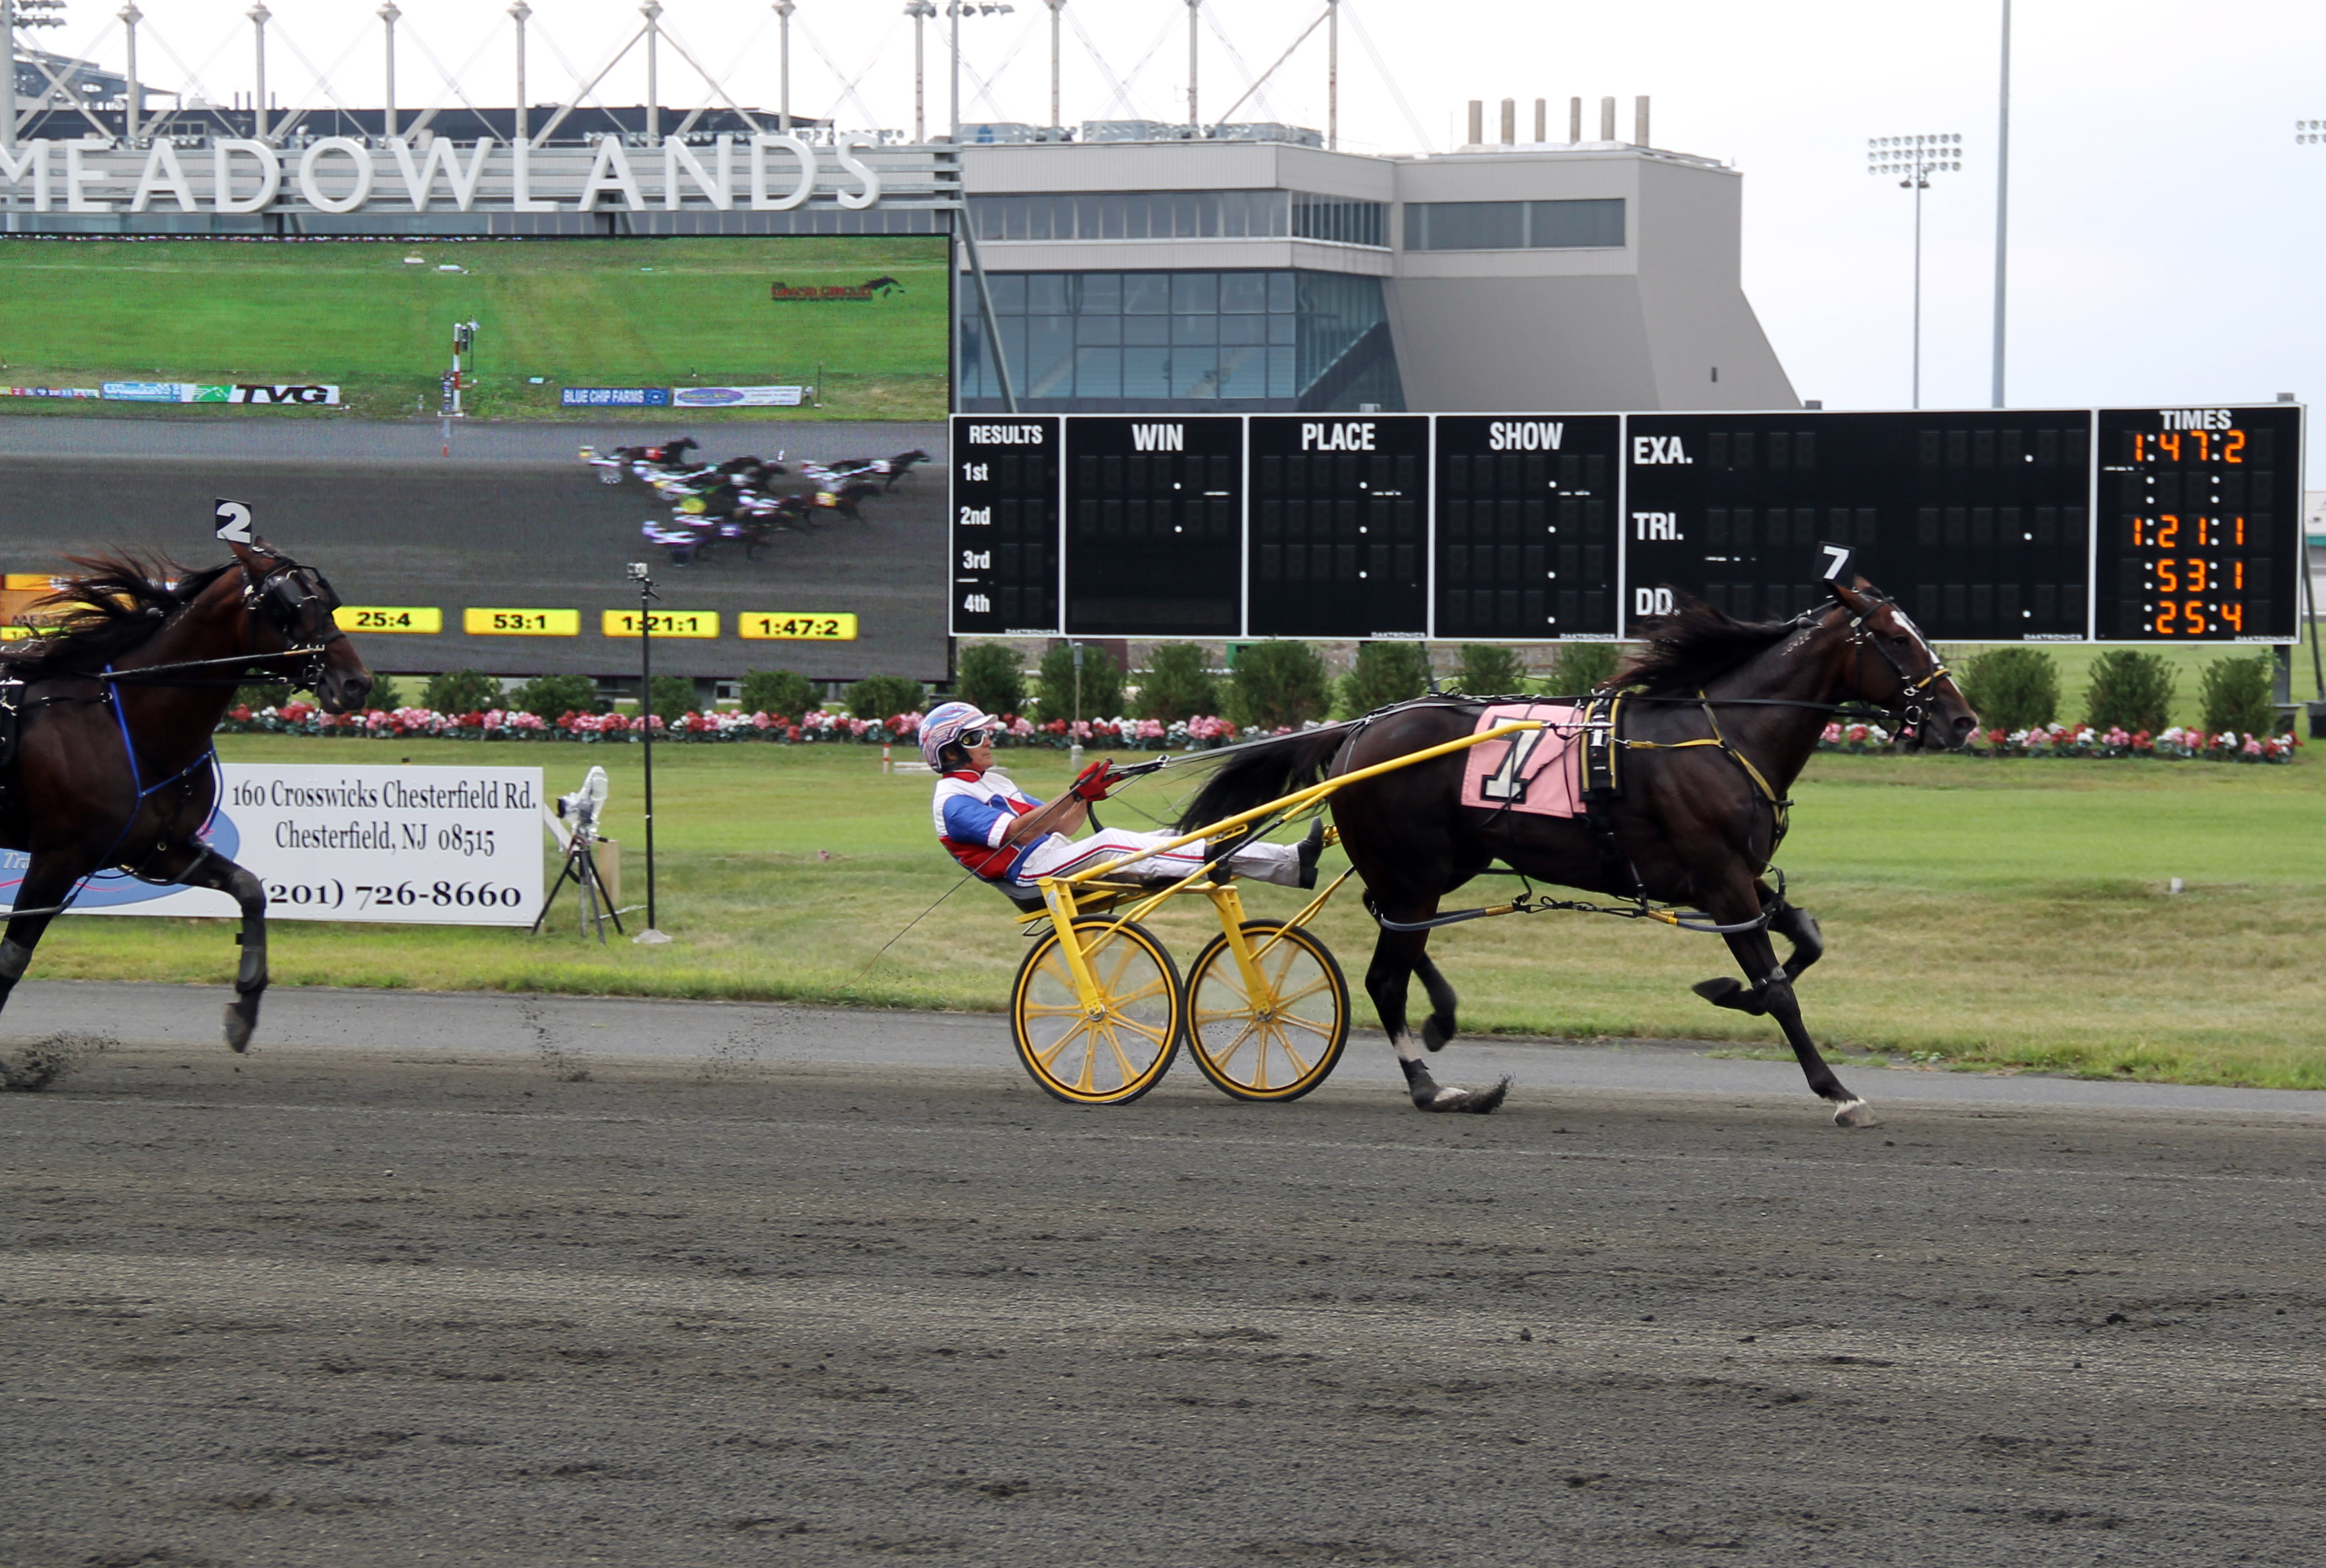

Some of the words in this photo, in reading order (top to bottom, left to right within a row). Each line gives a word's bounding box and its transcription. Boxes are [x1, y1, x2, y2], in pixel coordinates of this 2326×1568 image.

[0, 135, 880, 212] MEADOWLANDS
[235, 384, 328, 403] TVG
[563, 389, 588, 403] BLUE
[589, 389, 611, 403] CHIP
[612, 389, 645, 403] FARMS
[2160, 409, 2232, 430] TIMES
[970, 425, 1043, 444] RESULTS
[1132, 424, 1183, 451] WIN
[1302, 423, 1375, 451] PLACE
[1489, 422, 1564, 450] SHOW
[1633, 436, 1693, 464] EXA.
[962, 463, 988, 481] 1st
[216, 502, 251, 544] 2
[960, 506, 990, 525] 2nd
[1633, 512, 1684, 540] TRI.
[962, 551, 990, 569] 3rd
[1823, 545, 1850, 580] 7
[964, 595, 990, 612] 4th
[357, 612, 410, 627] 25:4
[494, 614, 545, 629] 53:1
[622, 616, 697, 631] 1:21:1
[760, 620, 839, 635] 1:47:2
[1481, 716, 1549, 803] 7
[233, 781, 265, 806] 160
[272, 779, 378, 808] Crosswicks
[383, 779, 499, 809] Chesterfield
[505, 781, 536, 809] Rd.
[276, 820, 396, 855] Chesterfield,
[402, 823, 428, 850] NJ
[439, 823, 494, 856] 08515
[355, 880, 522, 910] 726-8660
